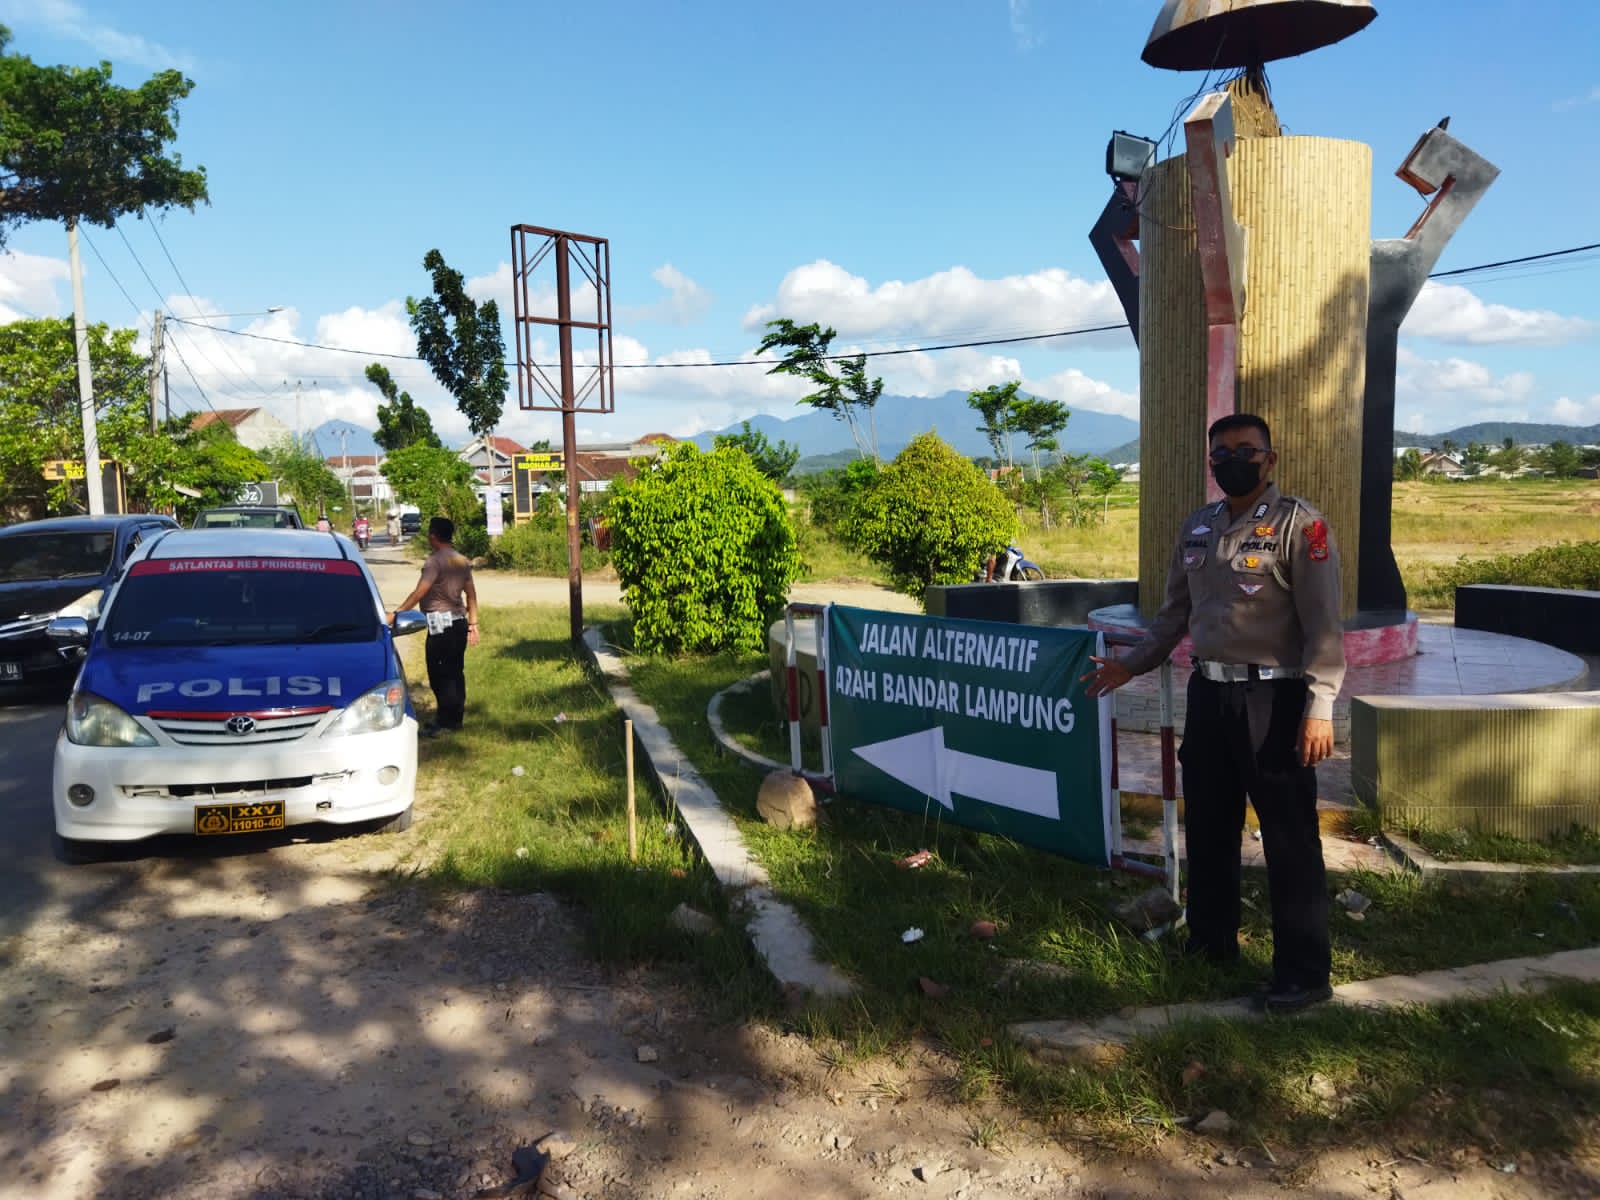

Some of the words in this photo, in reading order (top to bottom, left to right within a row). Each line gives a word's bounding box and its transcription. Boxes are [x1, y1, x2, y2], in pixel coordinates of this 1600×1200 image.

[1241, 542, 1277, 551] POLRI
[169, 560, 234, 571] SATLANTAS
[262, 561, 325, 571] PRINGSEWU
[113, 631, 151, 641] 14-07
[859, 623, 917, 657] JALAN
[922, 628, 1039, 673] ALTERNATIF
[137, 676, 342, 703] POLISI
[836, 665, 877, 701] ARAH
[883, 672, 960, 714] BANDAR
[965, 684, 1075, 734] LAMPUNG
[238, 805, 276, 817] XXV
[233, 818, 281, 831] 11010-40
